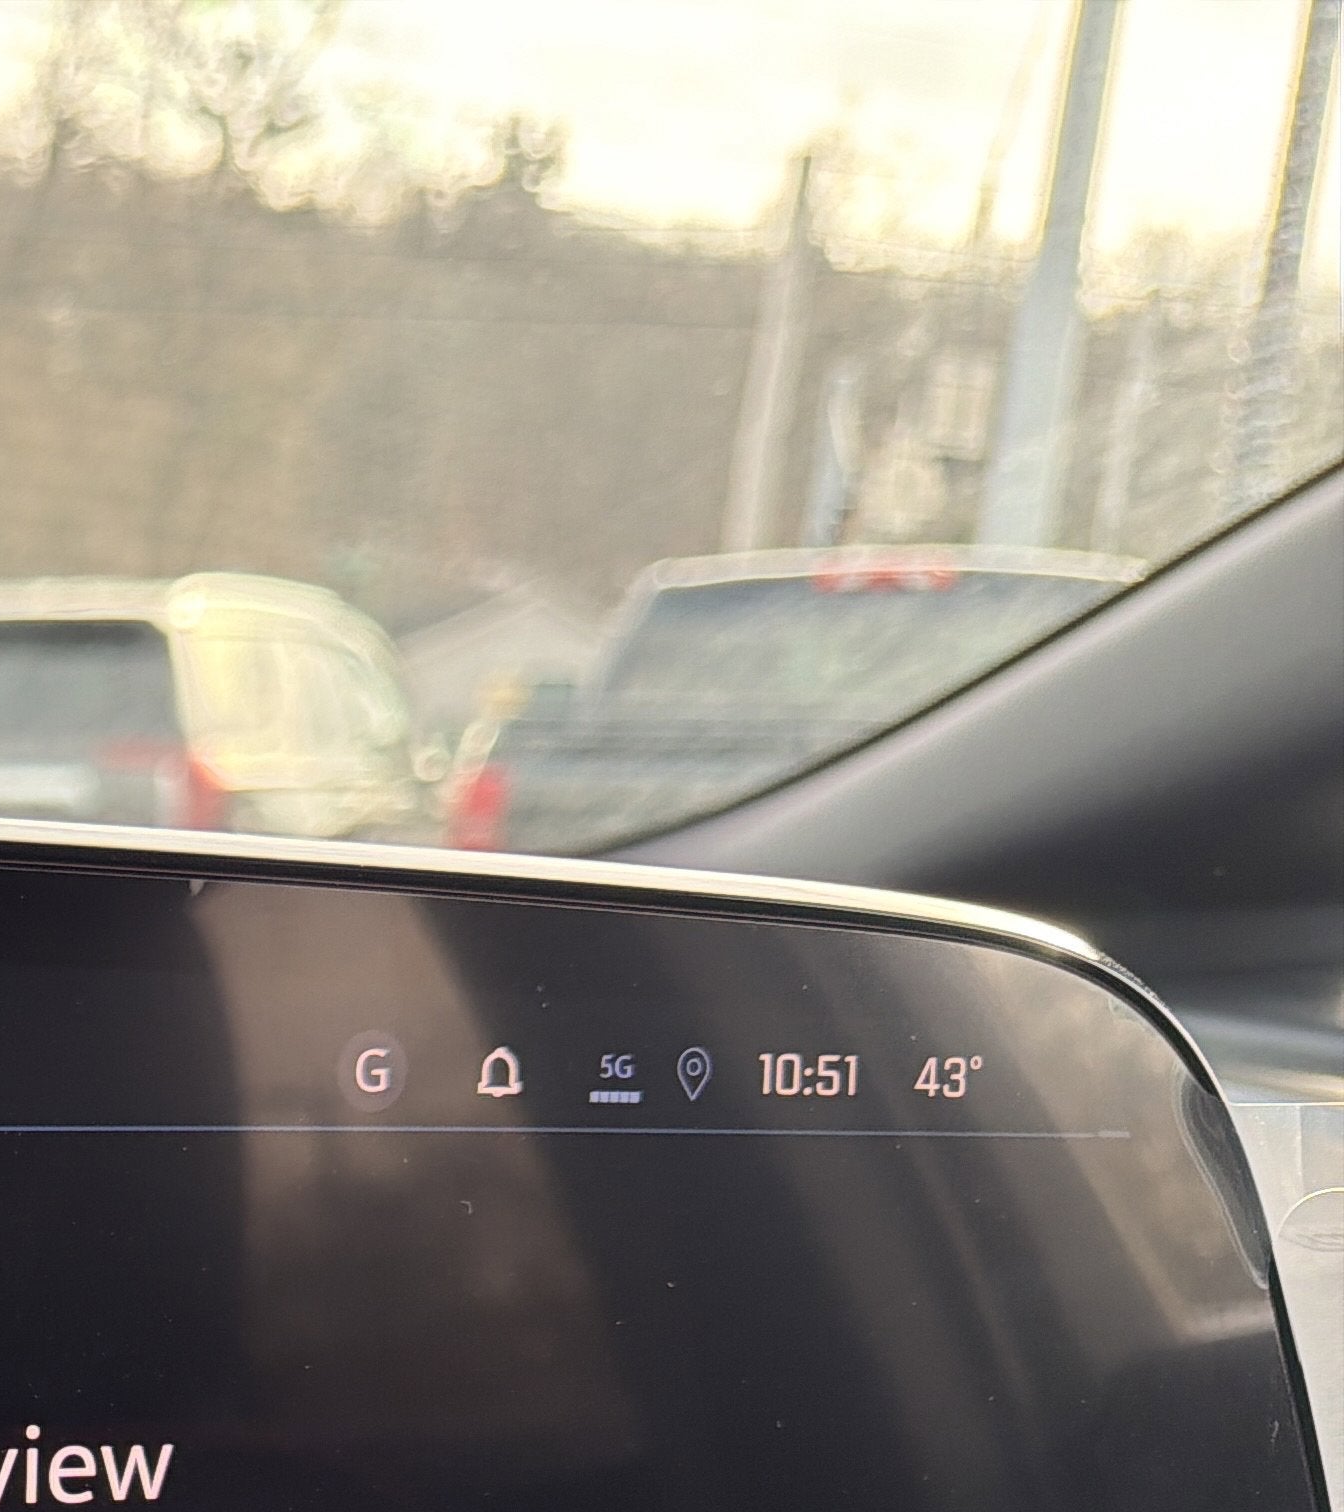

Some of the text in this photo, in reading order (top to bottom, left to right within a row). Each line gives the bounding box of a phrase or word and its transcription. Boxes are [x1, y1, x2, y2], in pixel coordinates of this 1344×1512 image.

[355, 1048, 388, 1093] G
[600, 1054, 634, 1079] 5G
[759, 1053, 983, 1098] 10:51 43°
